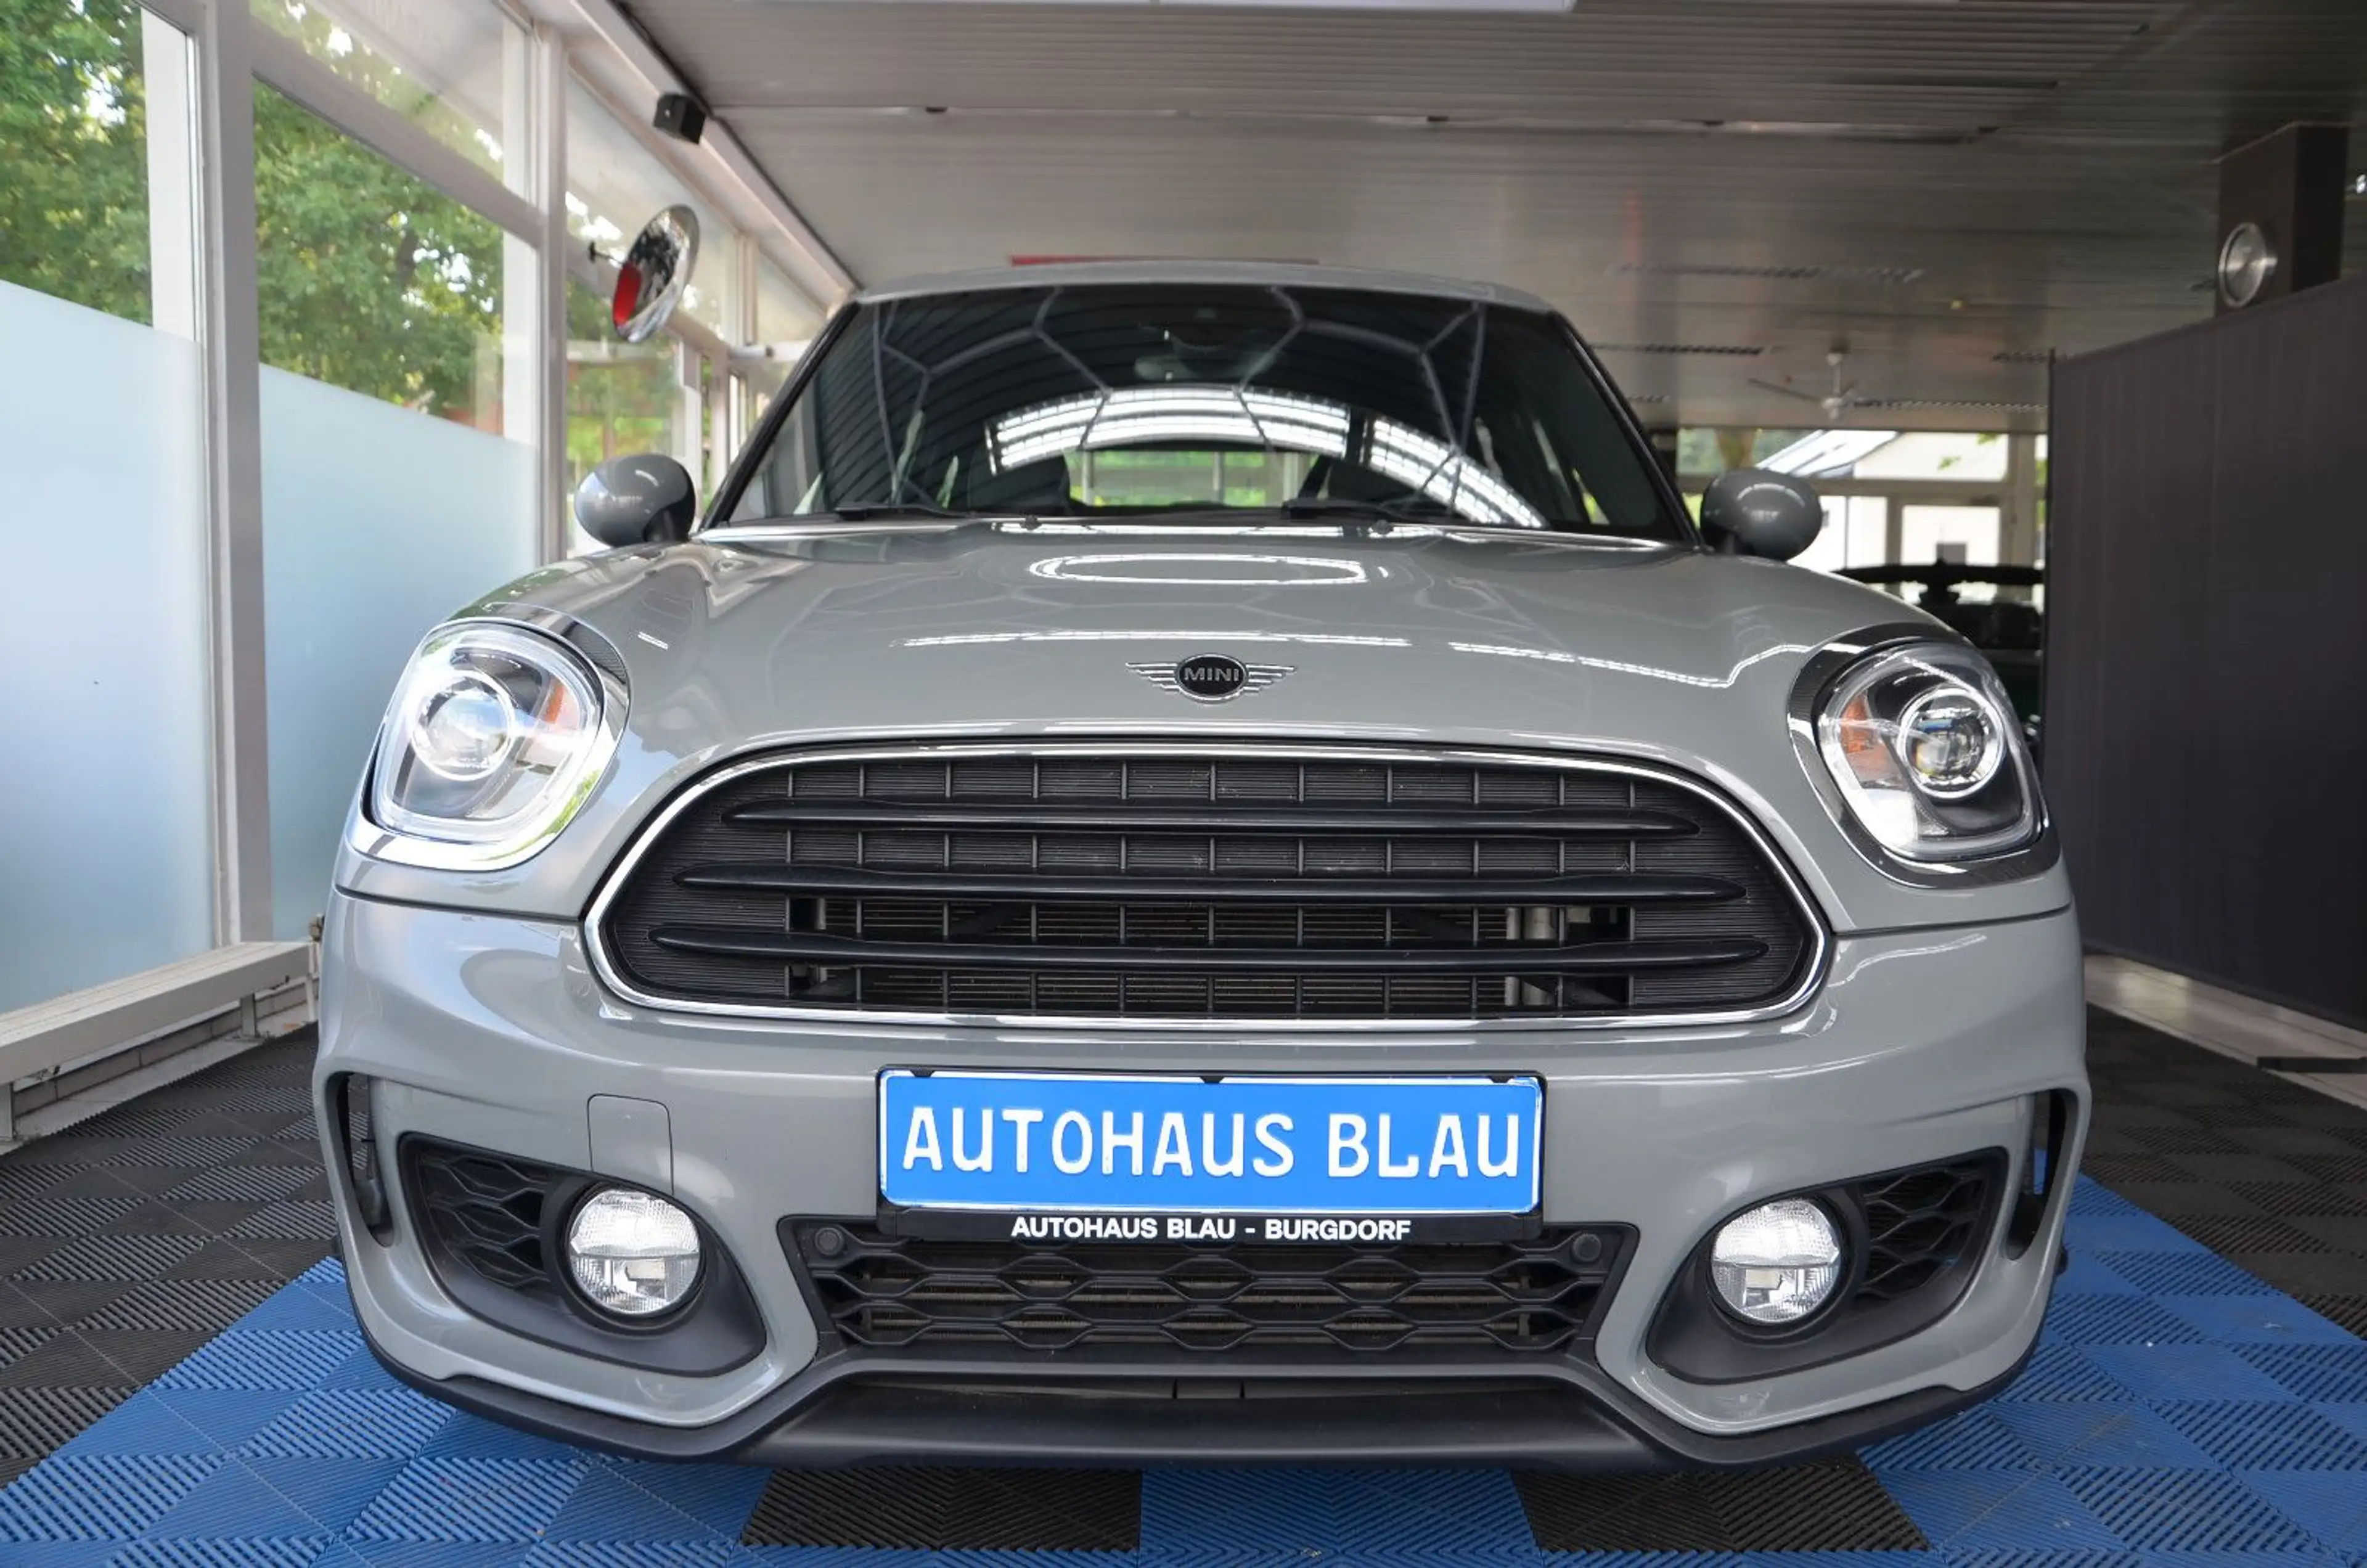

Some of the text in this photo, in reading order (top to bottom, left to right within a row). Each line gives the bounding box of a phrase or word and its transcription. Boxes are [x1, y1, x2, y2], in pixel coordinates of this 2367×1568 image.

[1184, 667, 1240, 682] MINI
[902, 1106, 1519, 1178] AUTOHAUS BLAU
[1010, 1216, 1158, 1239] AUTOHAUS
[1166, 1217, 1237, 1240] BLAU
[1264, 1218, 1412, 1241] BURGDORF
